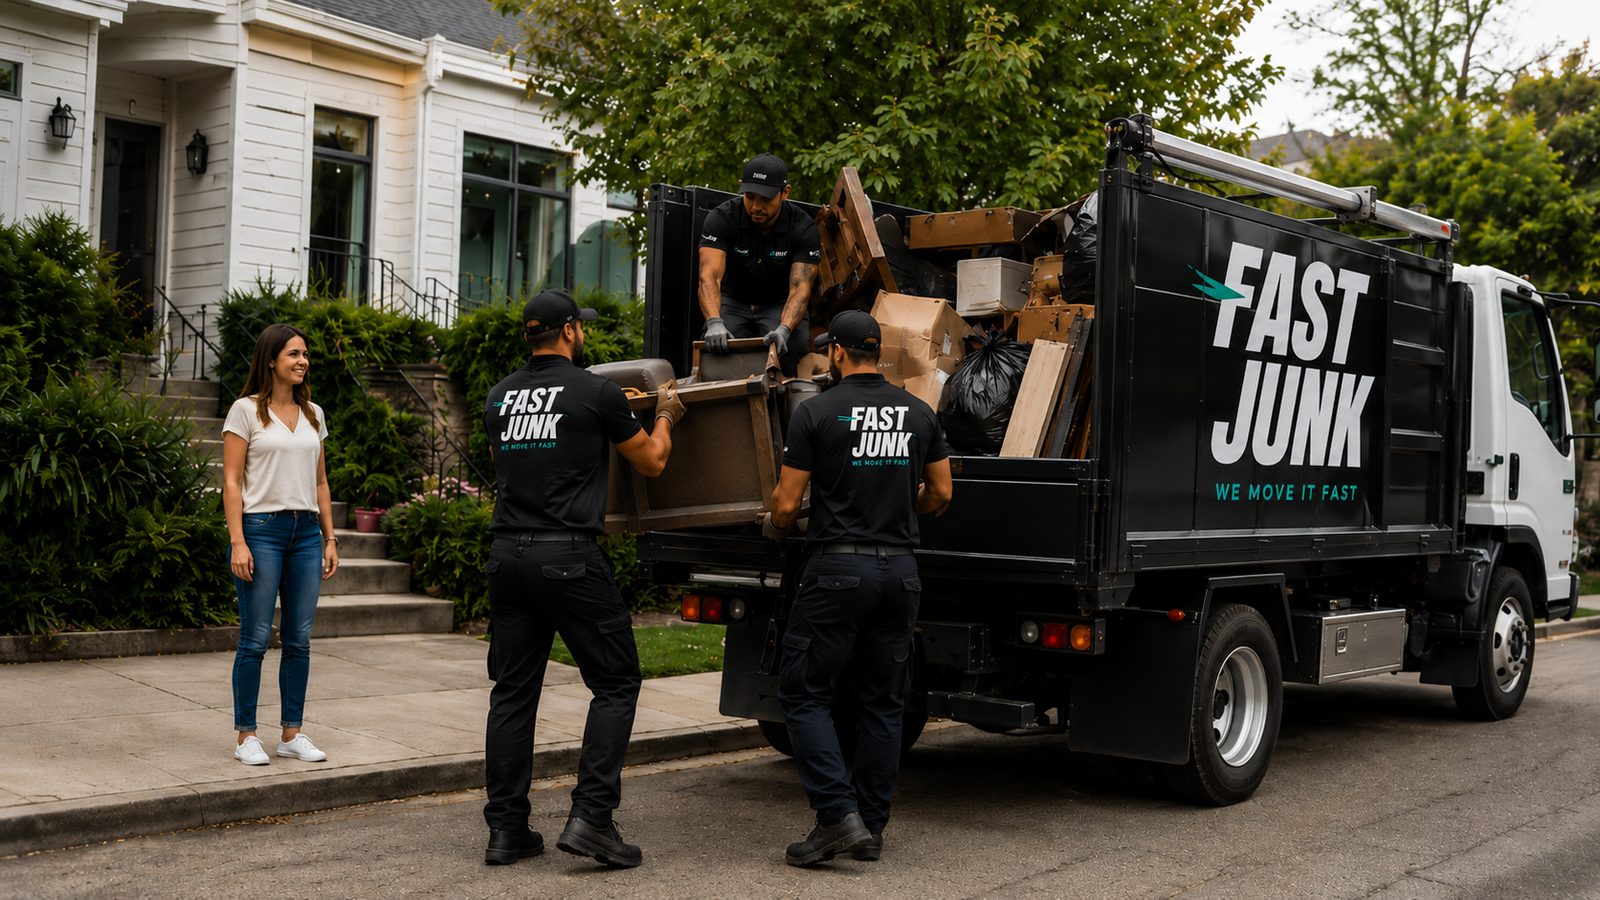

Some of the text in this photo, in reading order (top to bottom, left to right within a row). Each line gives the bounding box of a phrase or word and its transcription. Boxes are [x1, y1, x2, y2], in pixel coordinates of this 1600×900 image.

[1212, 241, 1371, 365] FAST
[498, 386, 565, 416] FAST
[1210, 359, 1376, 468] JUNK
[500, 413, 564, 442] JUNK
[849, 406, 910, 431] FAST
[851, 432, 913, 458] JUNK
[1215, 483, 1358, 501] WE MOVE IT FAST
